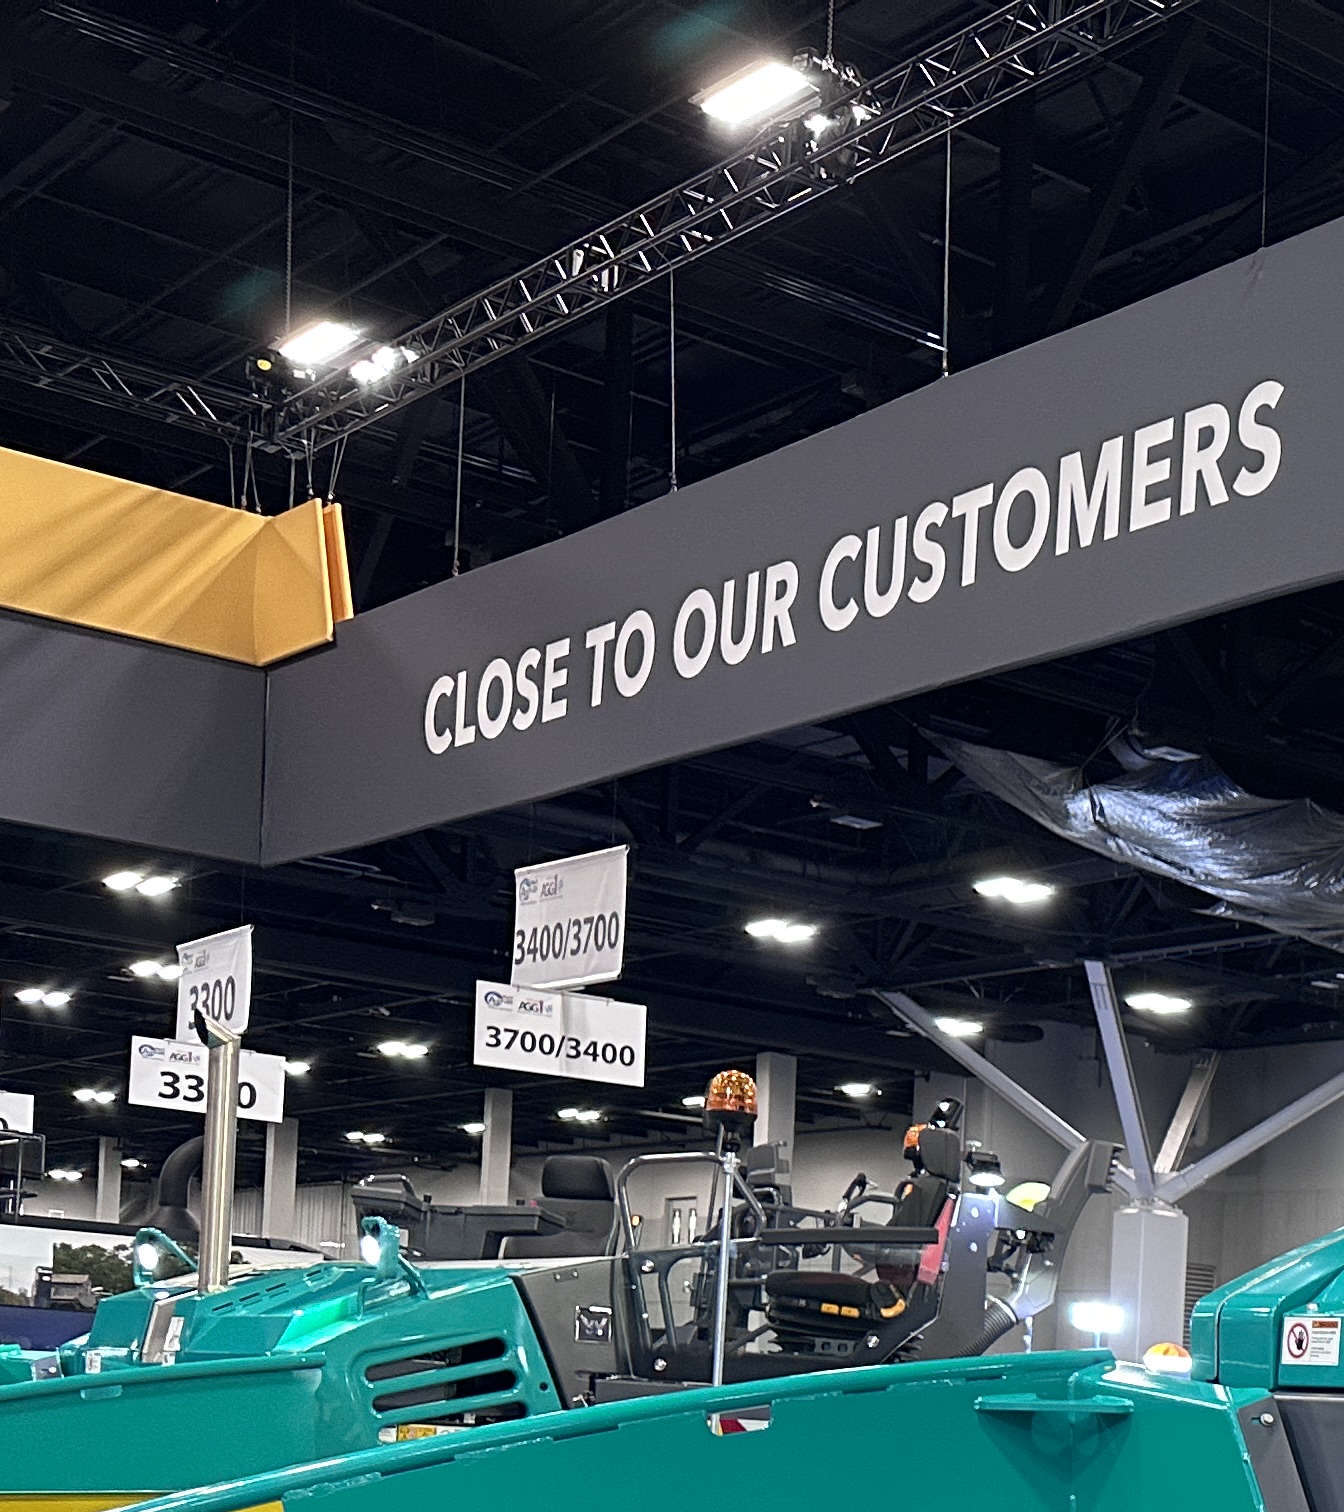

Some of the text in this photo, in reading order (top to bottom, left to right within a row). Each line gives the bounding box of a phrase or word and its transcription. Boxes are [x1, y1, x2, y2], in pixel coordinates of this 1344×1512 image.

[423, 379, 1285, 755] CLOSE TO OUR CUSTOMERS
[514, 911, 620, 965] 3400/3700
[485, 1025, 636, 1066] 3700/3400
[157, 1071, 257, 1109] 330
